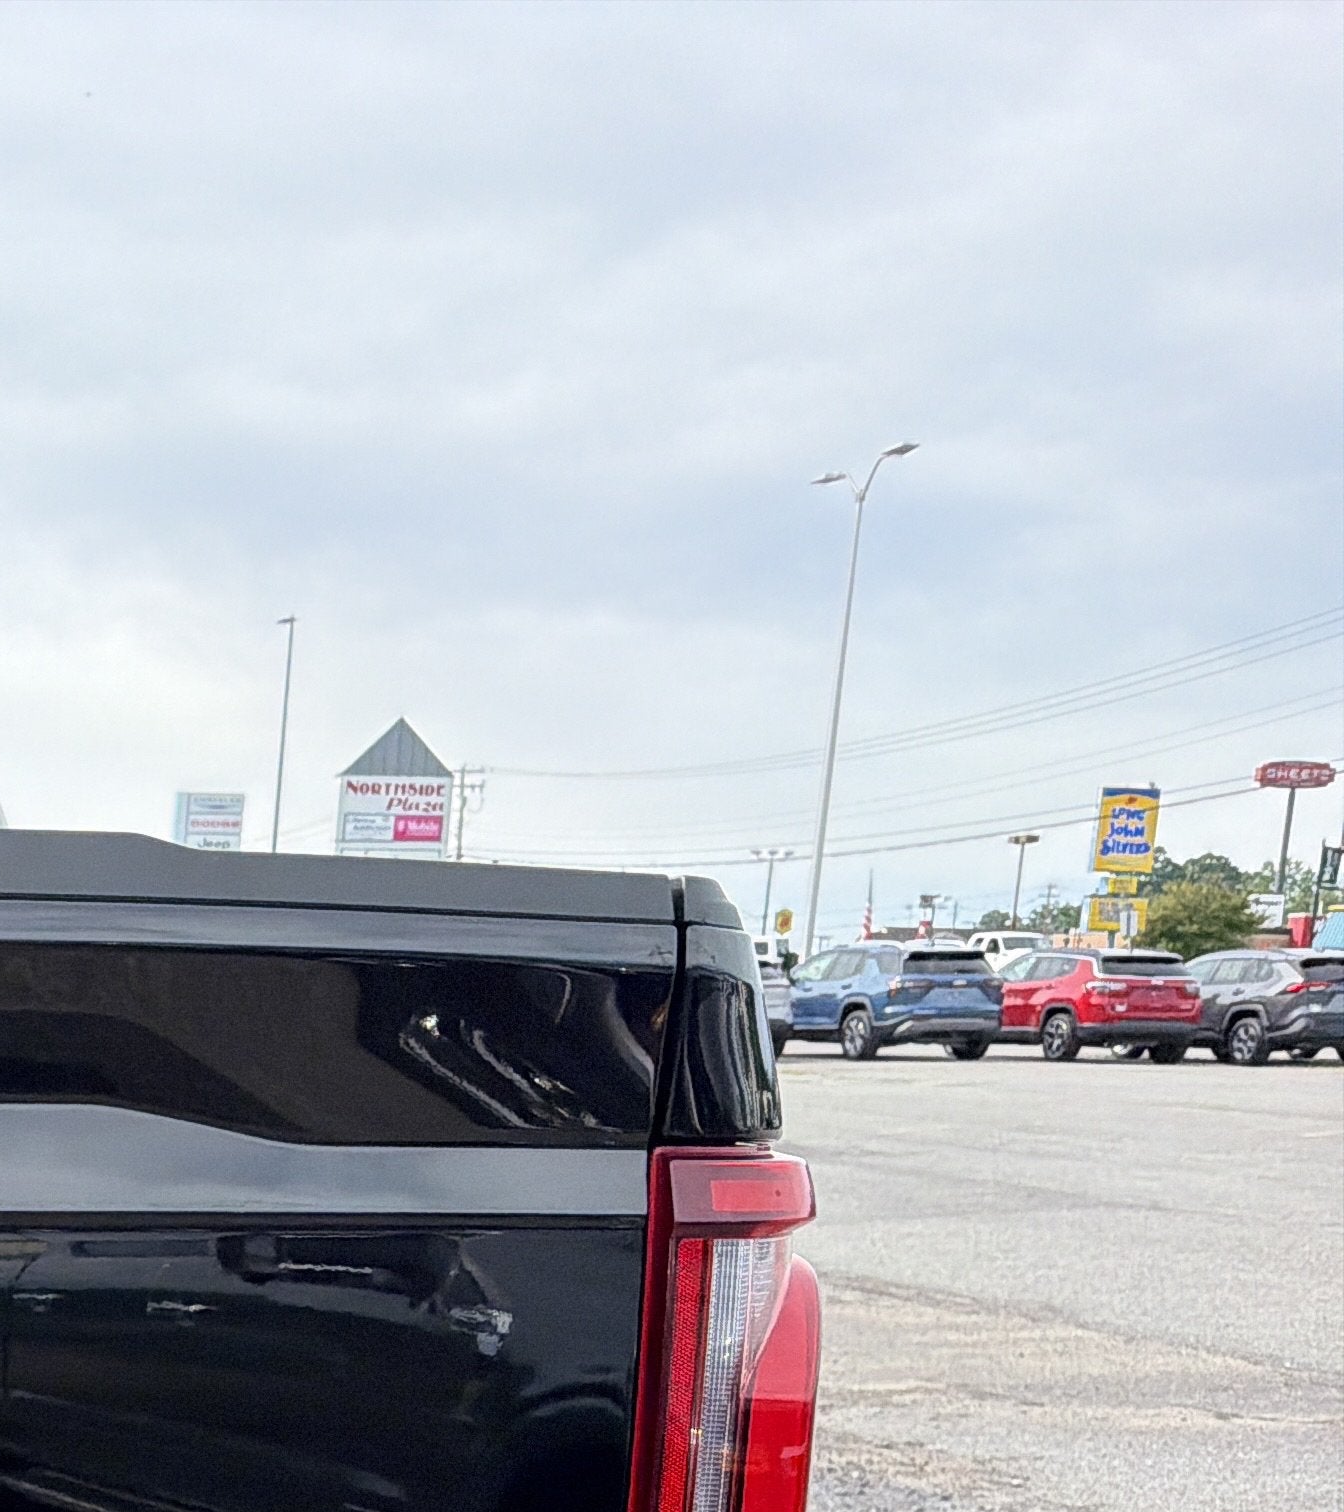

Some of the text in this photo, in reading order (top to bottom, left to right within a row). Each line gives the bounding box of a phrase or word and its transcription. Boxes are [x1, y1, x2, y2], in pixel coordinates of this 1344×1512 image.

[345, 781, 445, 797] NORTHSIDE
[386, 797, 444, 812] Plaza
[197, 837, 231, 849] Jeep
